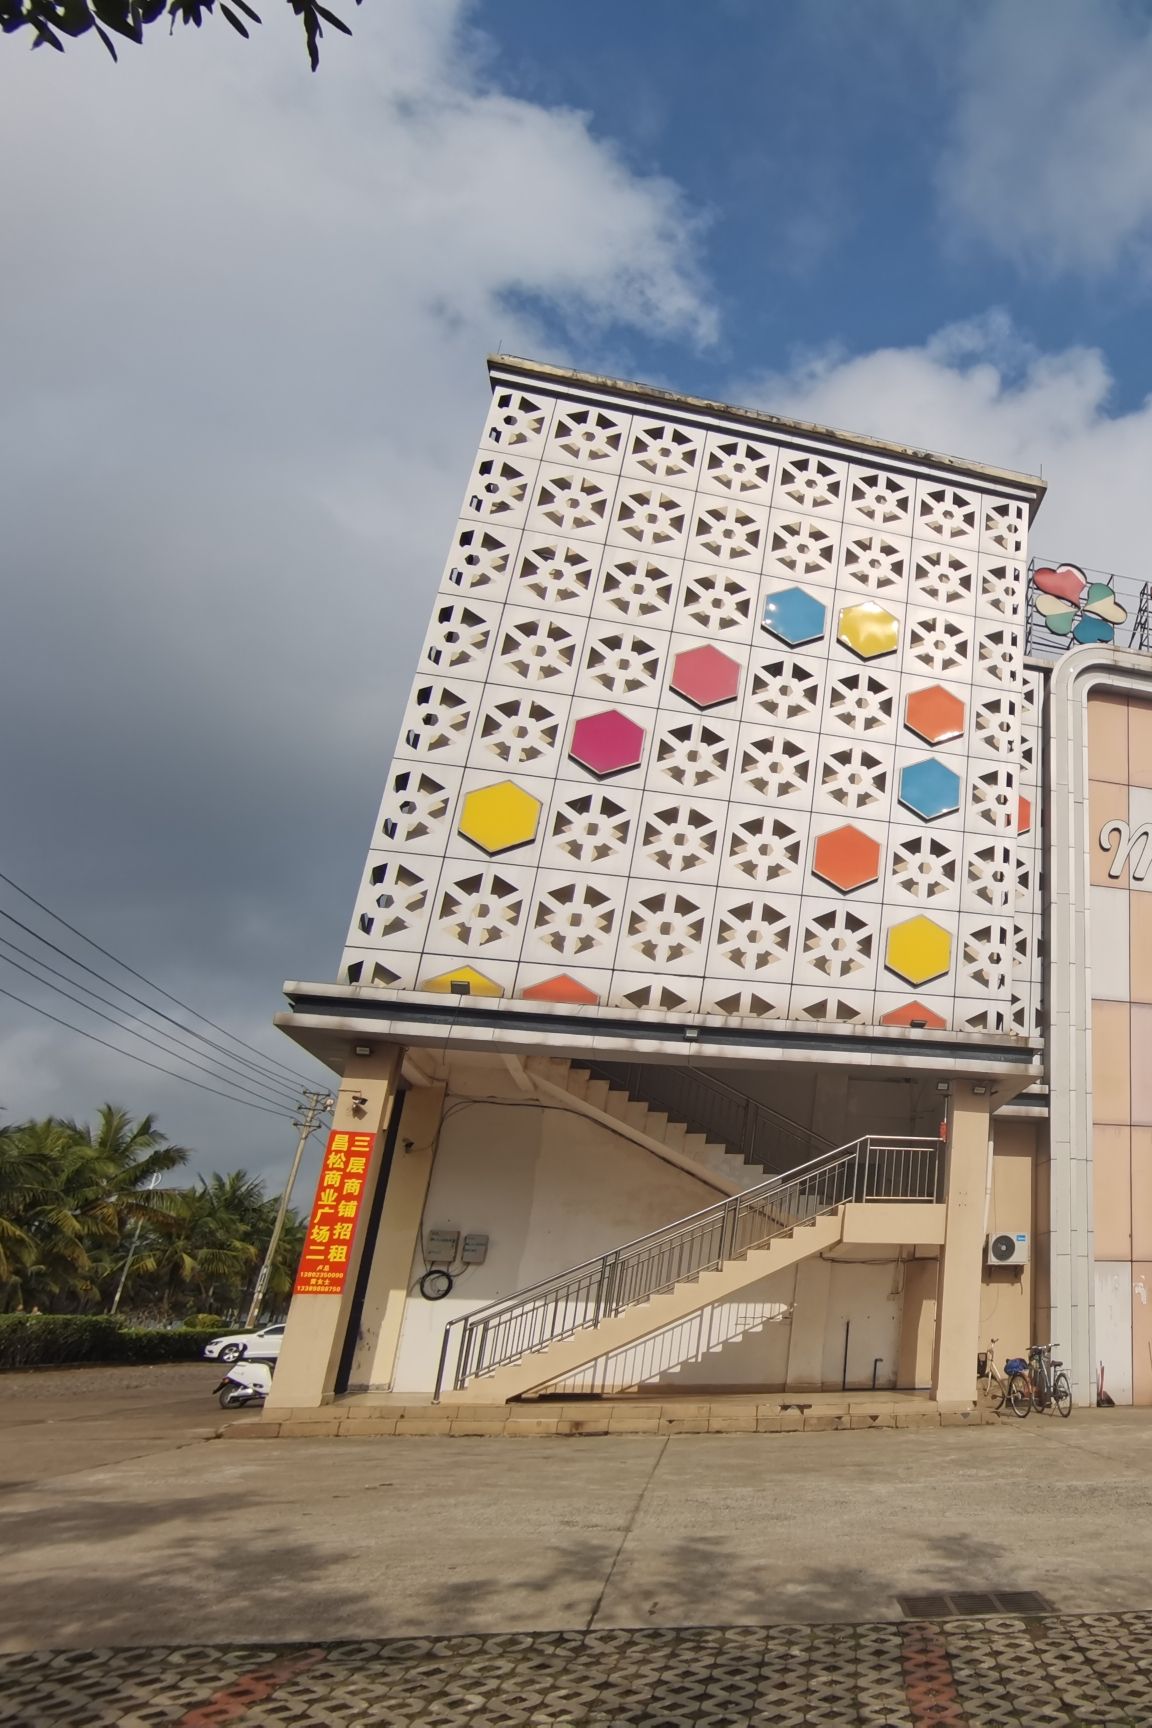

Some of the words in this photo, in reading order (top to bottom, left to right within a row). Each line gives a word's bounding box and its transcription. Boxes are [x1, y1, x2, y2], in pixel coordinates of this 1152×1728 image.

[306, 1134, 349, 1260] 昌松商业广场二
[328, 1136, 371, 1262] 三层商铺招租
